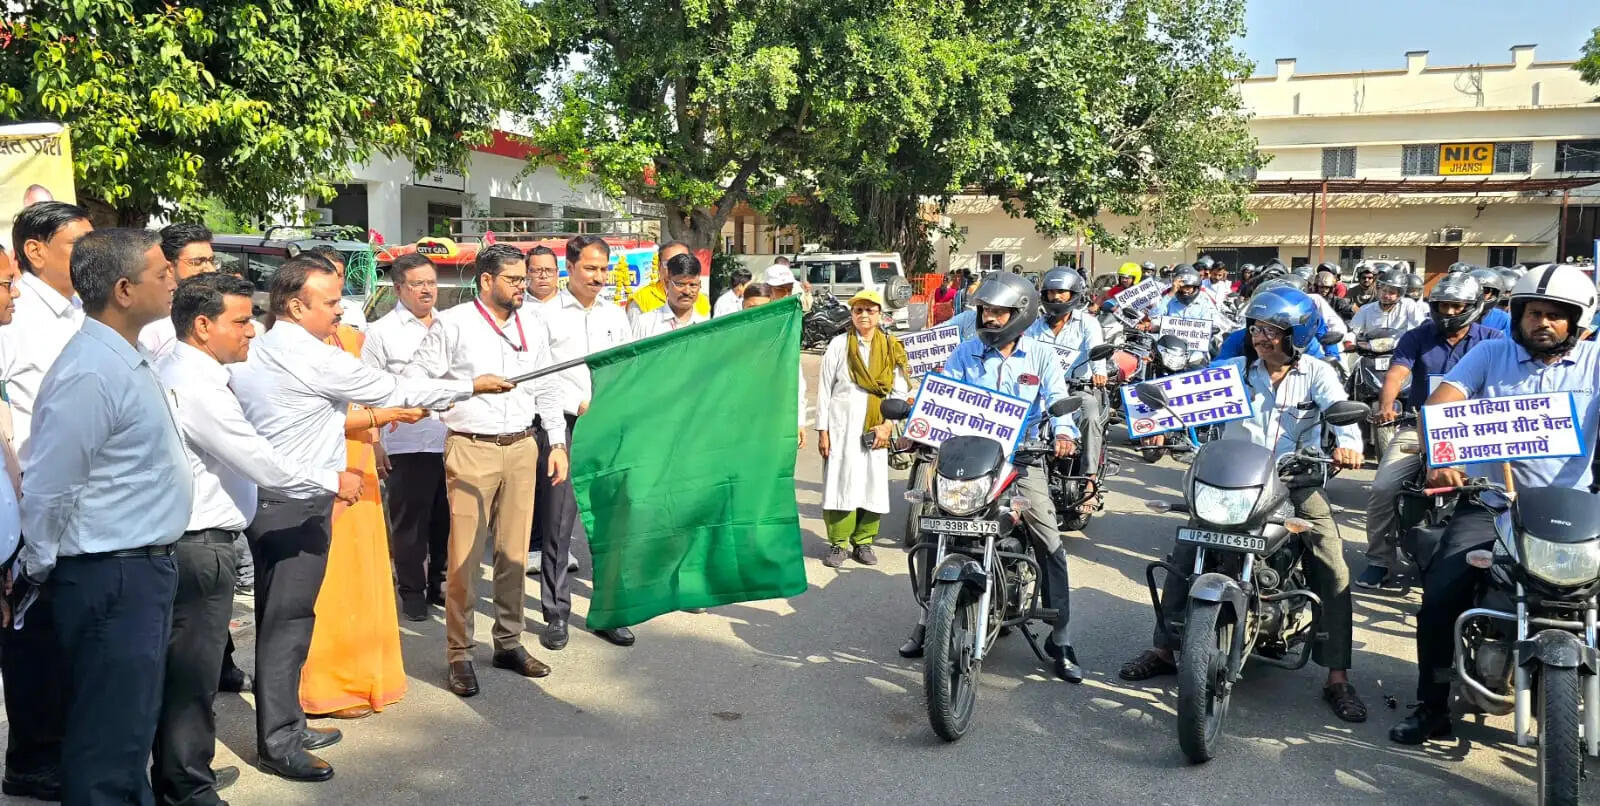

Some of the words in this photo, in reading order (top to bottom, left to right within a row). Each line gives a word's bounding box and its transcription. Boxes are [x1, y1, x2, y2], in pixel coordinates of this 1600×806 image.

[1445, 147, 1488, 161] NIC
[1450, 162, 1482, 173] JHANSI
[904, 336, 915, 346] हन
[916, 331, 937, 343] चलाते
[938, 328, 957, 339] समय
[929, 343, 946, 356] फोन
[1180, 368, 1232, 385] गति
[926, 379, 957, 398] वाहन
[957, 388, 993, 409] चलाते
[994, 399, 1027, 420] समय
[1167, 386, 1233, 407] वाहन
[1158, 414, 1176, 427] न
[1180, 400, 1244, 423] चलायें
[1443, 405, 1466, 418] चार
[1469, 399, 1510, 415] पहिया
[1514, 397, 1550, 411] वाहन
[921, 398, 968, 426] मोबाइल
[968, 413, 996, 434] फोन
[996, 423, 1015, 441] का
[1429, 422, 1469, 440] चलाते
[1473, 420, 1508, 437] समय
[1511, 416, 1539, 433] सीट
[928, 427, 958, 443] प्रयो
[1458, 442, 1501, 459] अवश्य
[1505, 435, 1549, 455] लगायें
